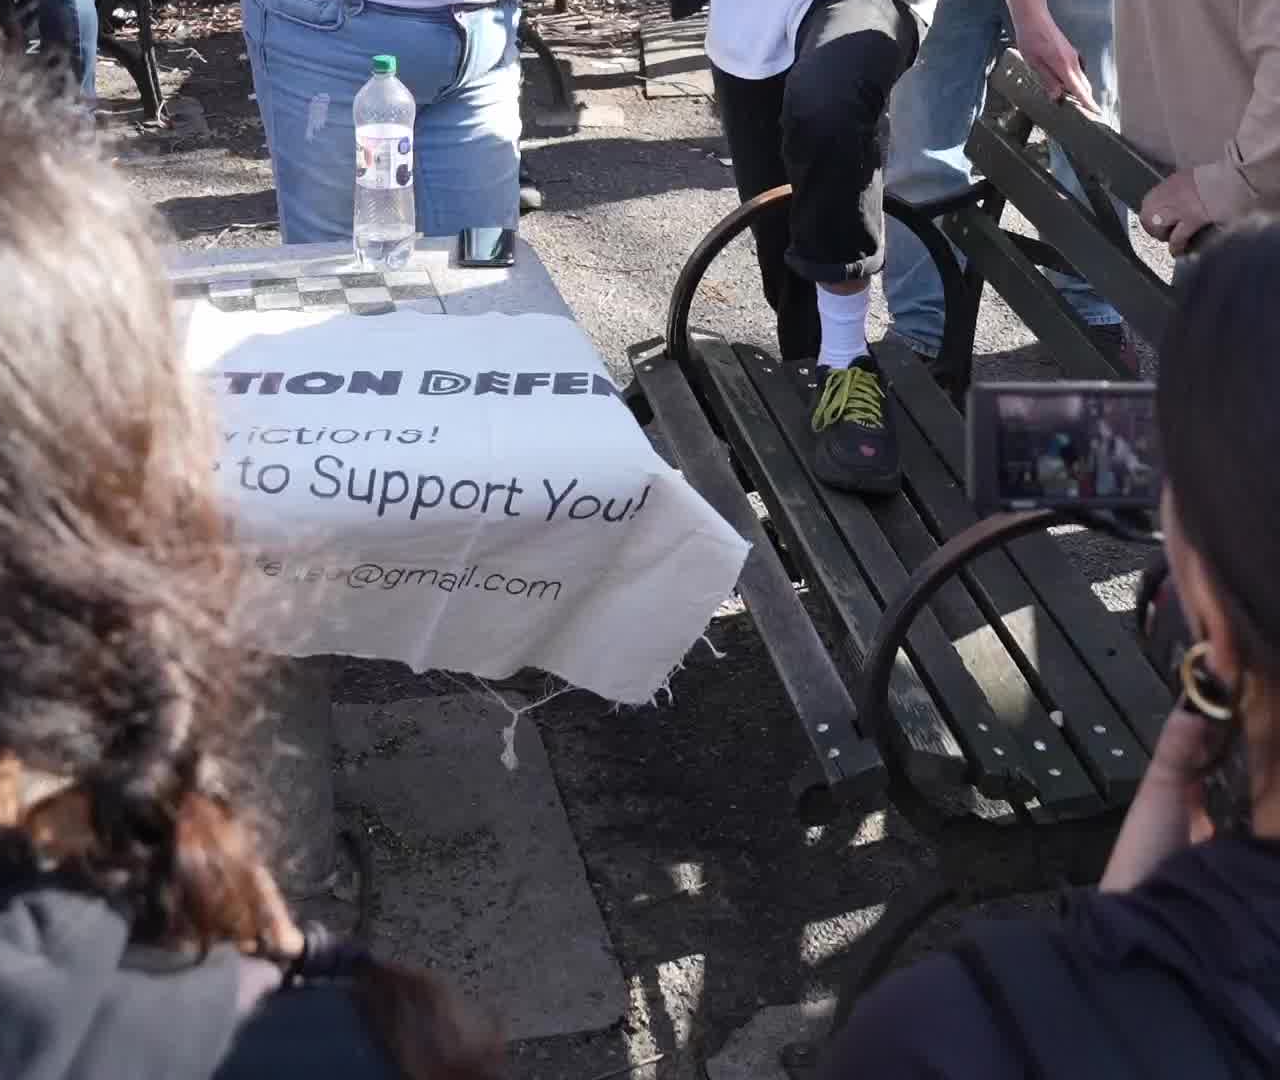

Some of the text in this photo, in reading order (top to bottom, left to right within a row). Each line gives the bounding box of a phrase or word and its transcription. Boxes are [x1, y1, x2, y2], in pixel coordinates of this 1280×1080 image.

[222, 370, 404, 396] TION
[223, 425, 440, 445] victions!
[239, 455, 651, 522] to Support You!
